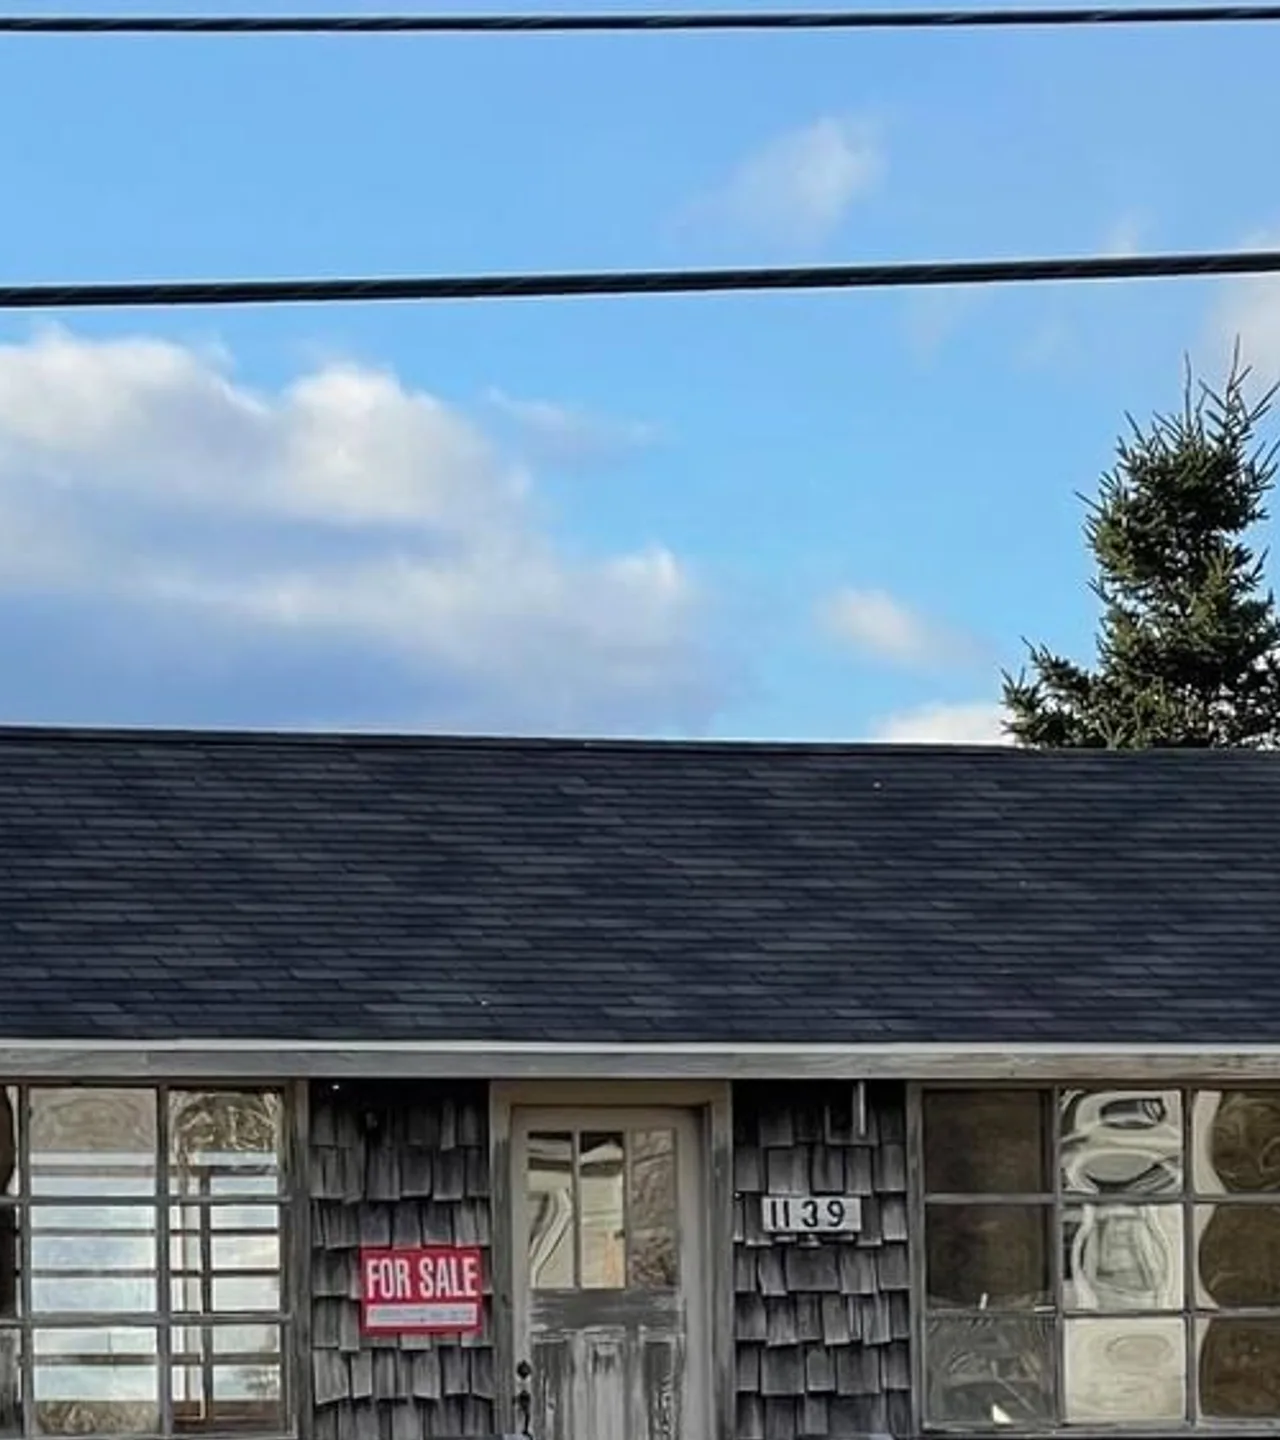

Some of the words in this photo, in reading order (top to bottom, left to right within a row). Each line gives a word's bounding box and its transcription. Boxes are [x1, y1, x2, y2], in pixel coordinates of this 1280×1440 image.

[770, 1200, 845, 1228] 1139
[366, 1258, 412, 1299] FOR
[419, 1256, 479, 1298] SALE
